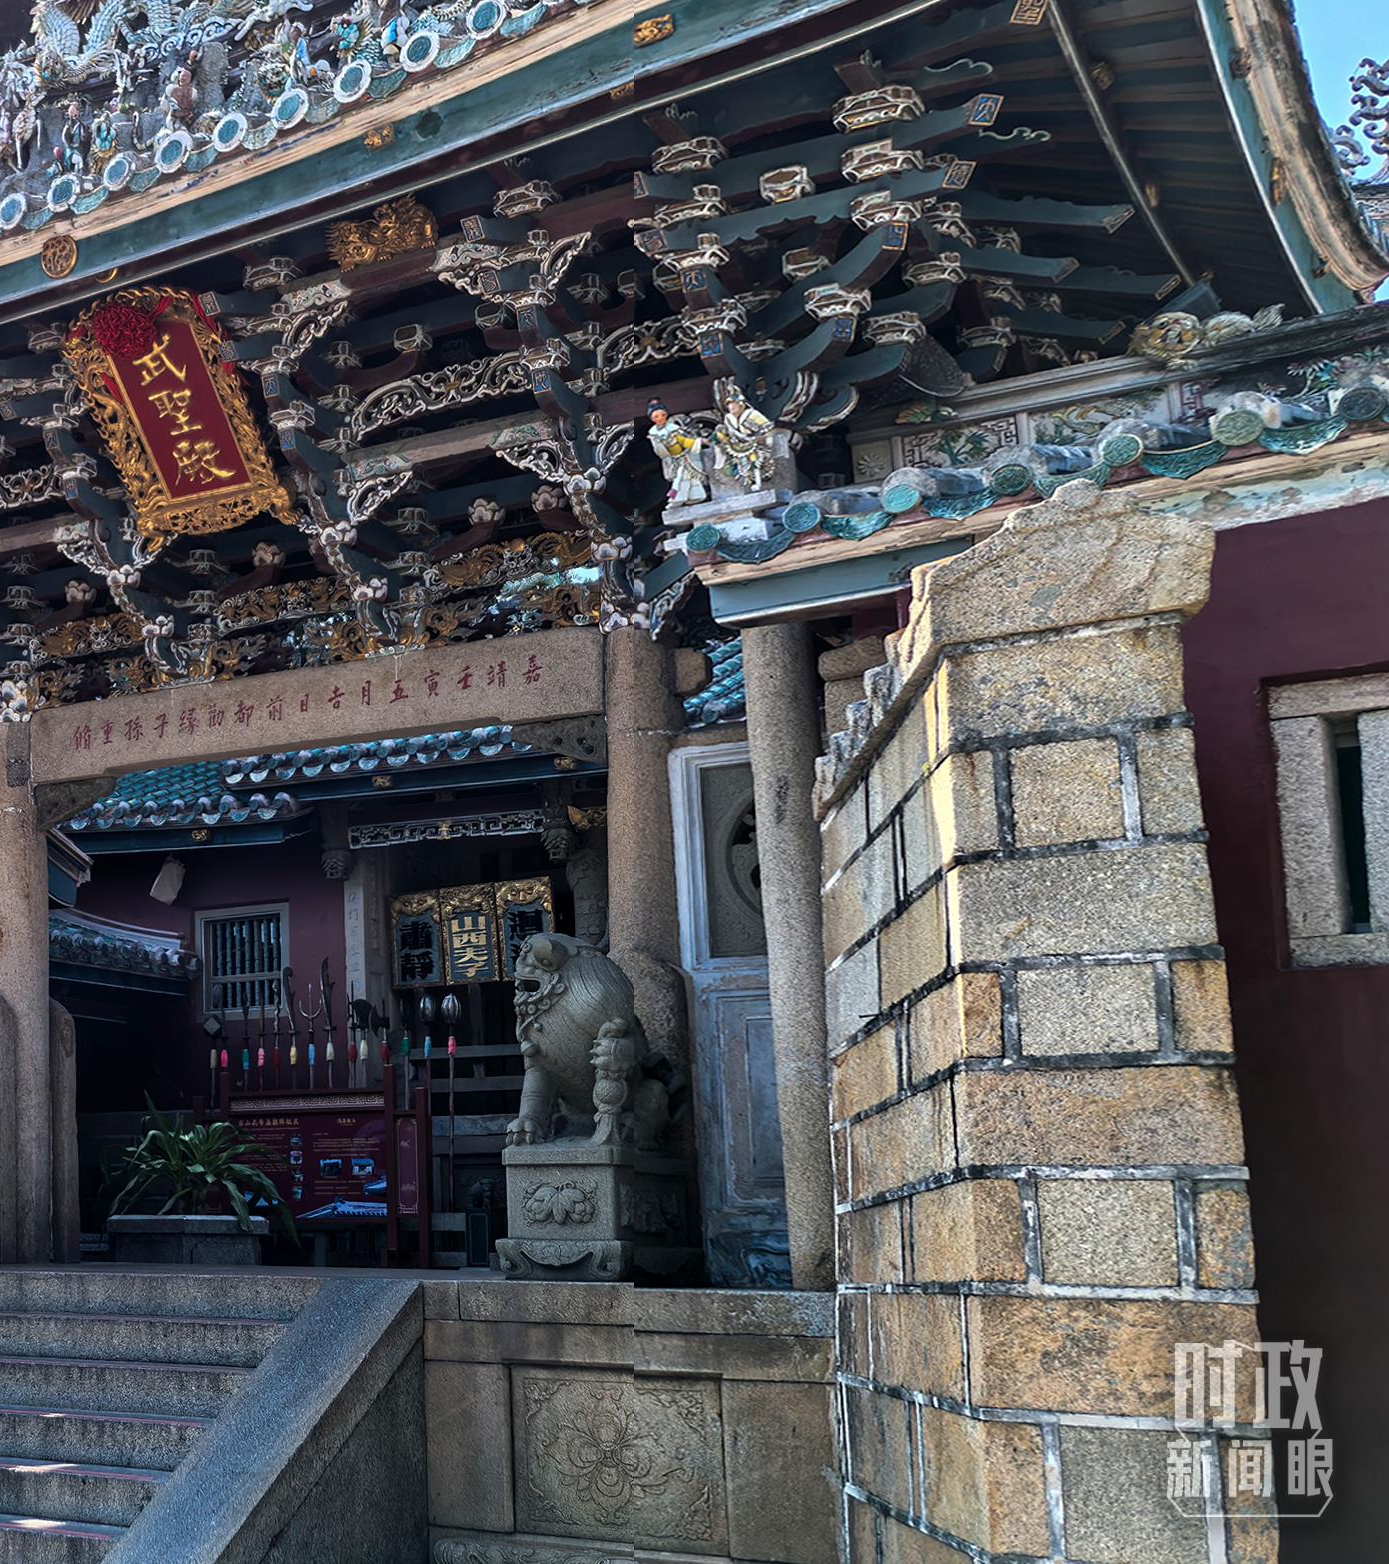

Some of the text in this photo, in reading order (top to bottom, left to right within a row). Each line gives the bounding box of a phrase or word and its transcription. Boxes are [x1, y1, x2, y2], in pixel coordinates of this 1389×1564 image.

[131, 333, 237, 486] 武聖殿
[450, 915, 489, 978] 山西夫子
